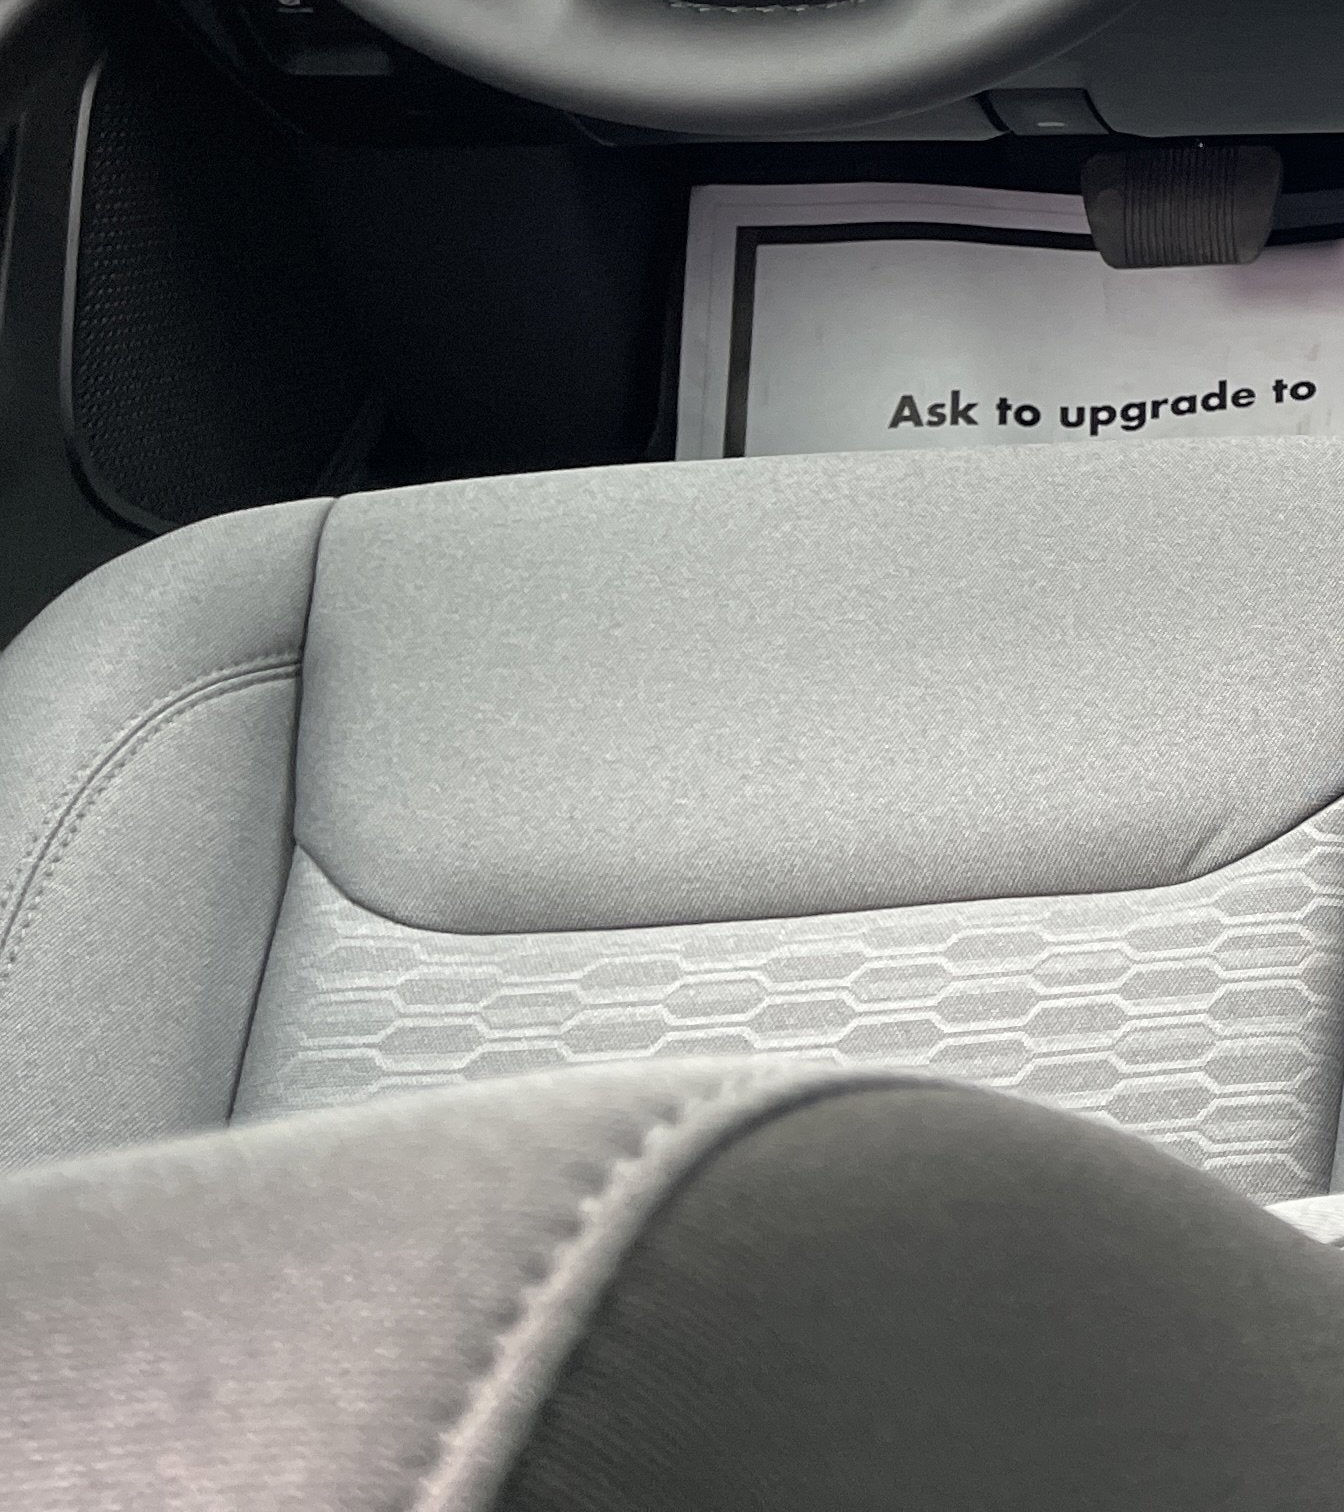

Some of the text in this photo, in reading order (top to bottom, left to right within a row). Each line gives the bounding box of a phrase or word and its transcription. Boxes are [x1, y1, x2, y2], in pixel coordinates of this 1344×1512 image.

[887, 377, 1318, 436] Ask to upgrade to
